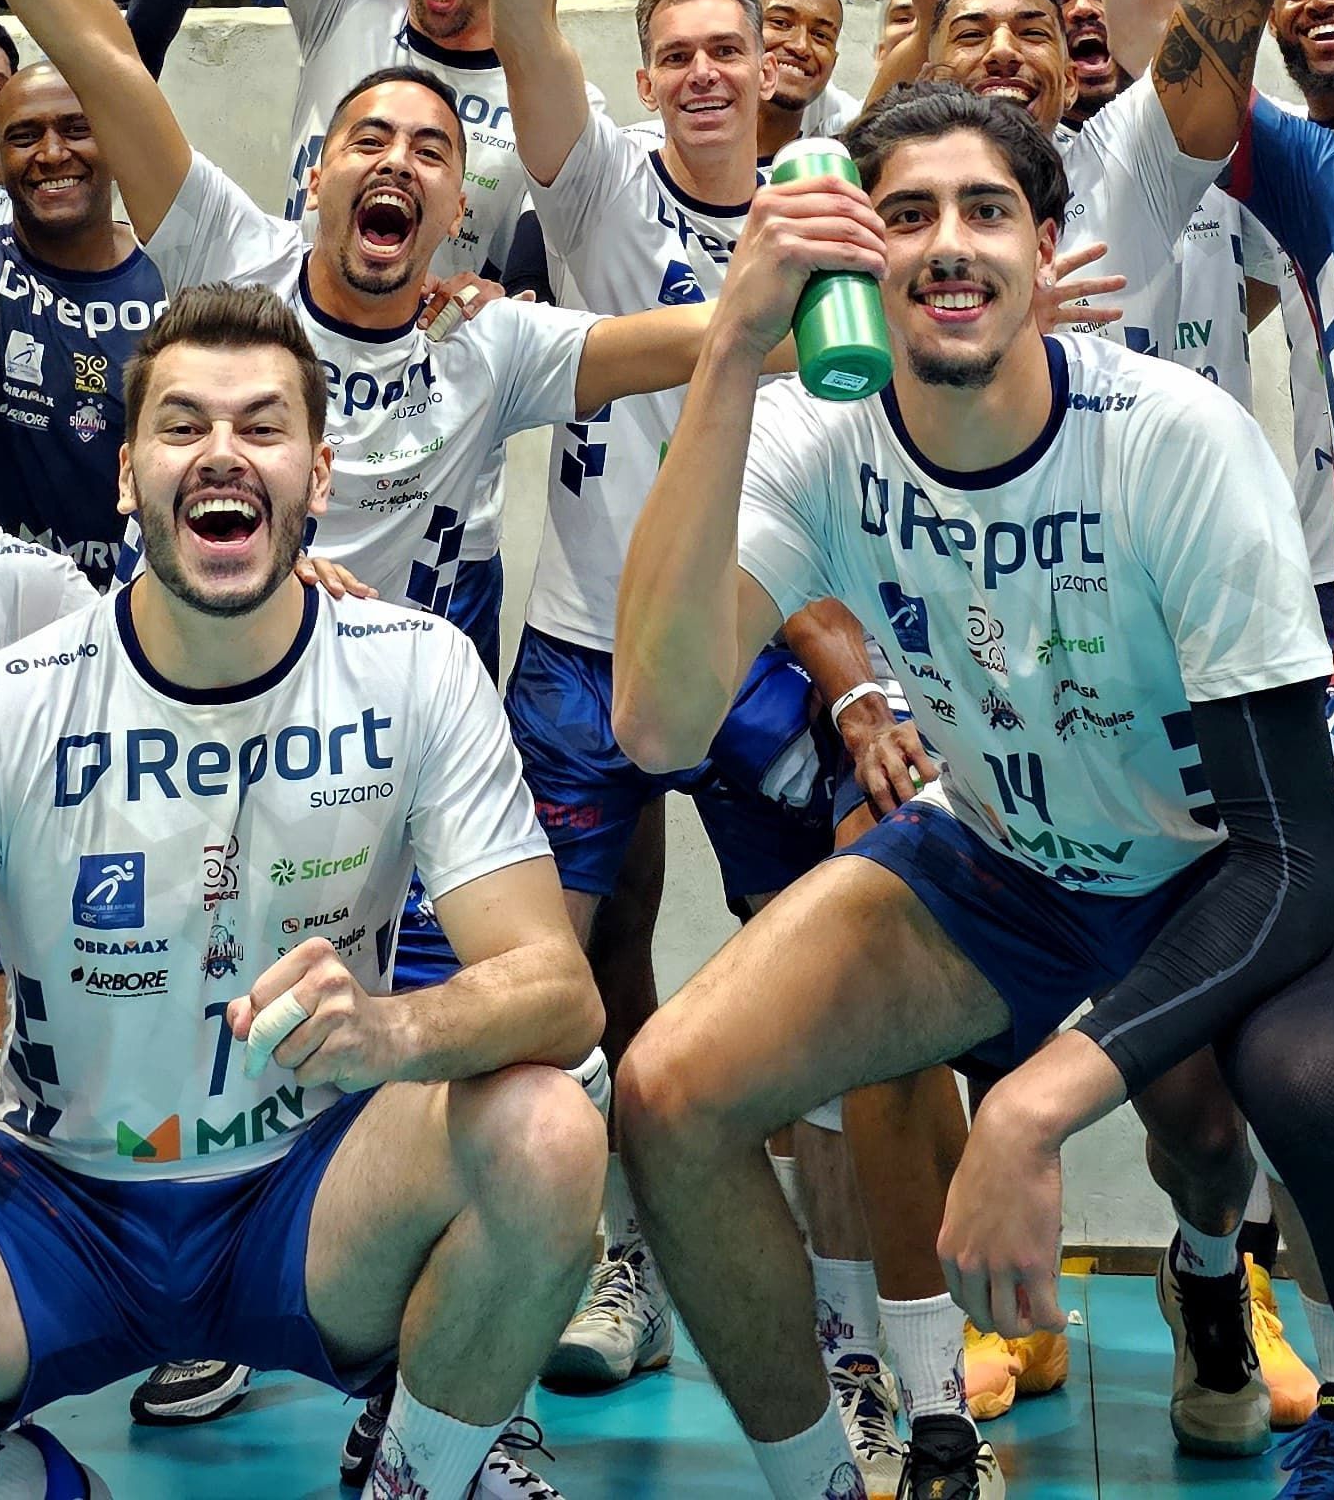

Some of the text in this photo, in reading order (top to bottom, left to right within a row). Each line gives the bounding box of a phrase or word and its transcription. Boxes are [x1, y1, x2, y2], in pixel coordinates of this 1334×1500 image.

[471, 131, 516, 152] suzan
[464, 171, 500, 191] credi
[447, 237, 473, 252] ICAL
[458, 227, 480, 244] holas
[1175, 319, 1213, 350] RV
[69, 415, 107, 431] SUZANO
[1052, 574, 1107, 592] uzano
[336, 618, 435, 639] KOMATSU
[923, 694, 956, 719] ORE
[127, 707, 394, 810] Report
[310, 781, 394, 809] suzano
[983, 752, 1054, 826] 14
[1006, 824, 1135, 865] MRV
[301, 846, 371, 880] Sicredi
[303, 907, 350, 930] PULSA
[74, 937, 169, 956] OBRAMAX
[331, 925, 367, 953] cholas
[85, 966, 169, 991] ÁRBORE
[196, 1083, 305, 1155] MRV
